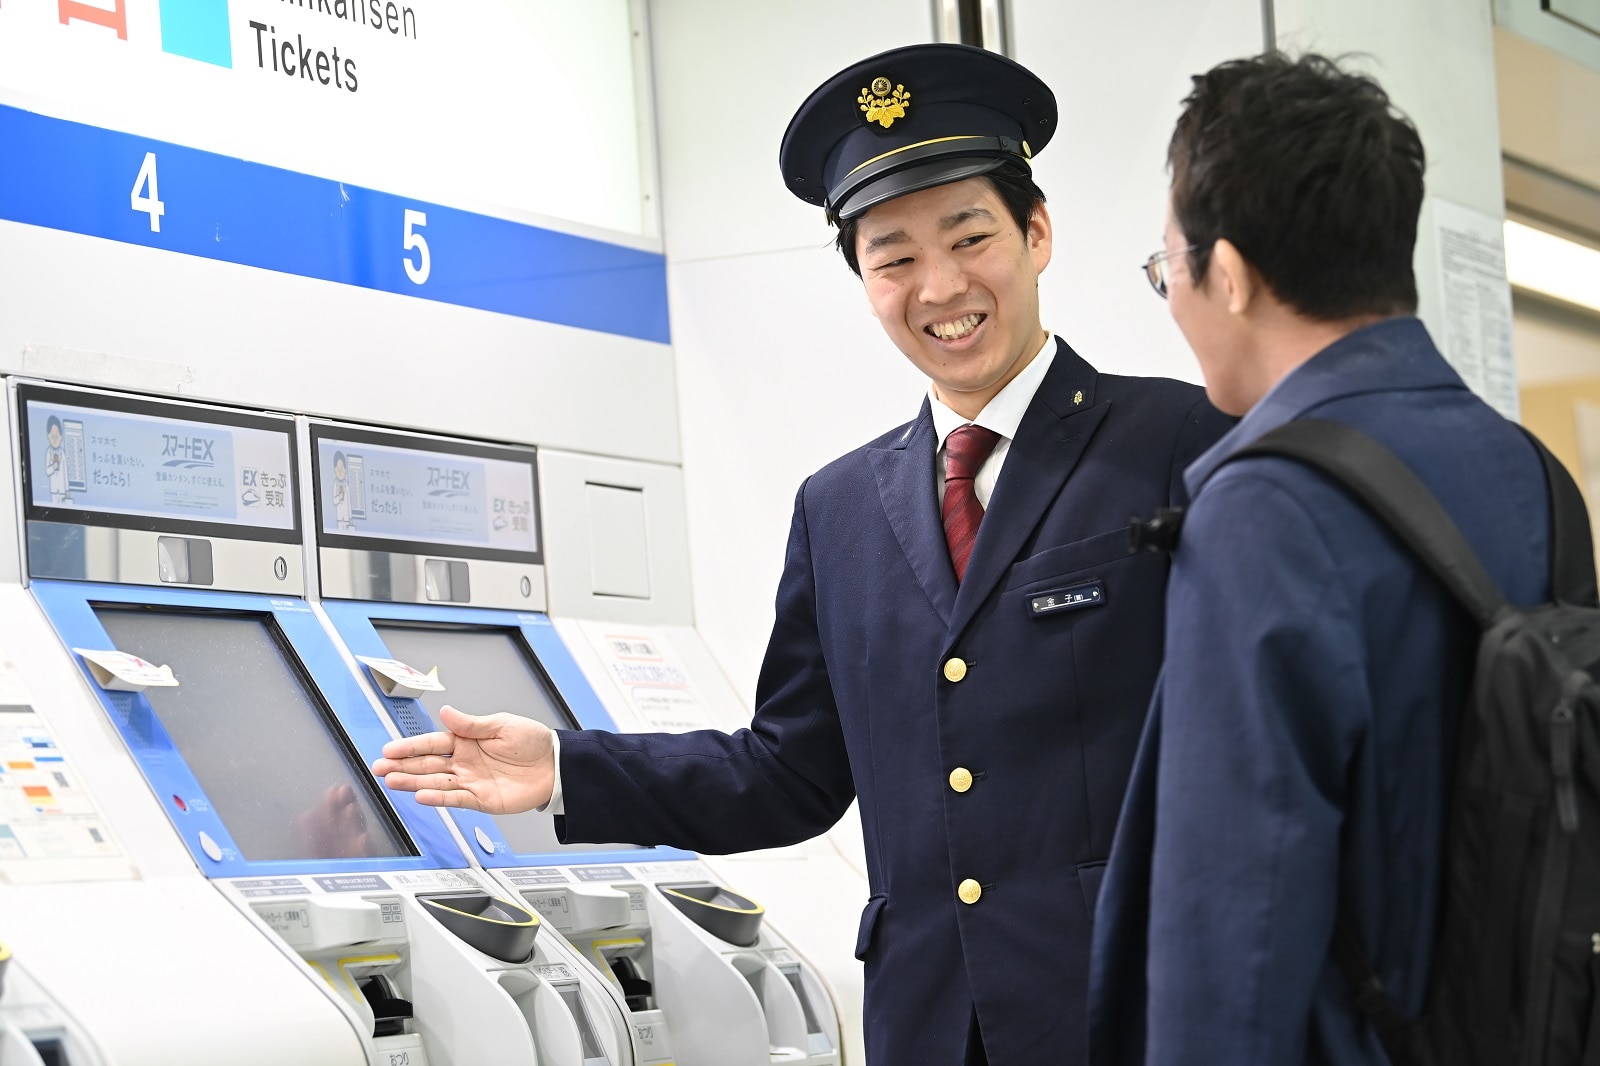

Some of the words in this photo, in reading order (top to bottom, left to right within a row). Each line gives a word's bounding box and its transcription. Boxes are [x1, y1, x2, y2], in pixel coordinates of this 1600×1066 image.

[249, 20, 359, 93] Tickets
[130, 152, 166, 233] 4
[402, 208, 432, 285] 5
[161, 434, 215, 461] スマートEX
[242, 470, 258, 487] EX
[260, 471, 287, 488] きっぷ
[427, 467, 470, 490] スマートEX
[265, 490, 285, 508] 受取
